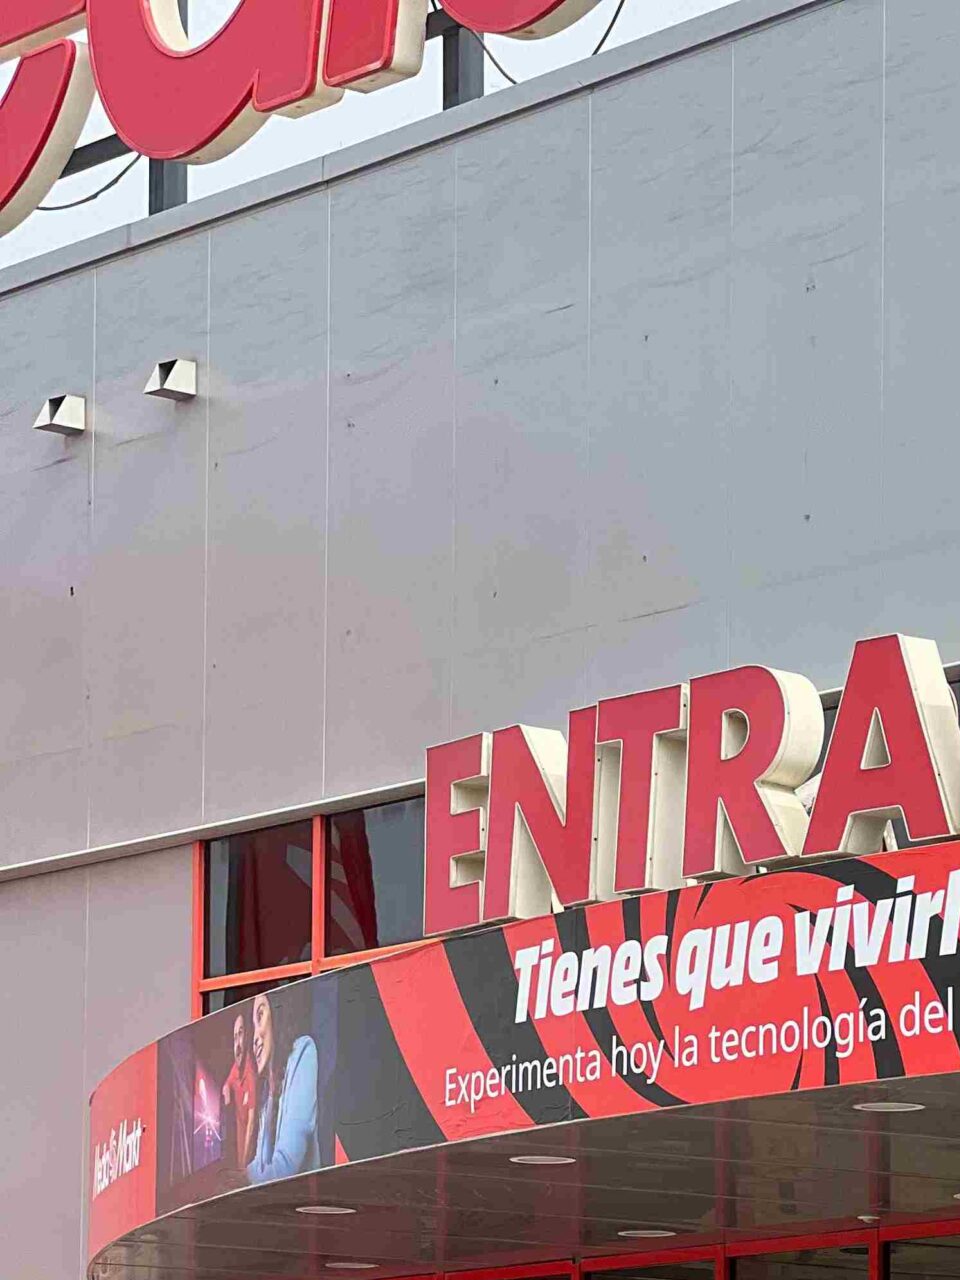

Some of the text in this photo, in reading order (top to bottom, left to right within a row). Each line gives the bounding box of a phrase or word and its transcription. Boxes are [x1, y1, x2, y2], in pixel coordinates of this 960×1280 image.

[514, 938, 666, 1023] Tienes
[675, 913, 782, 1010] que
[445, 1046, 602, 1112] Experimenta
[611, 1034, 661, 1086] hoy
[673, 1023, 700, 1068] la
[708, 998, 888, 1064] tecnología
[901, 988, 955, 1036] del
